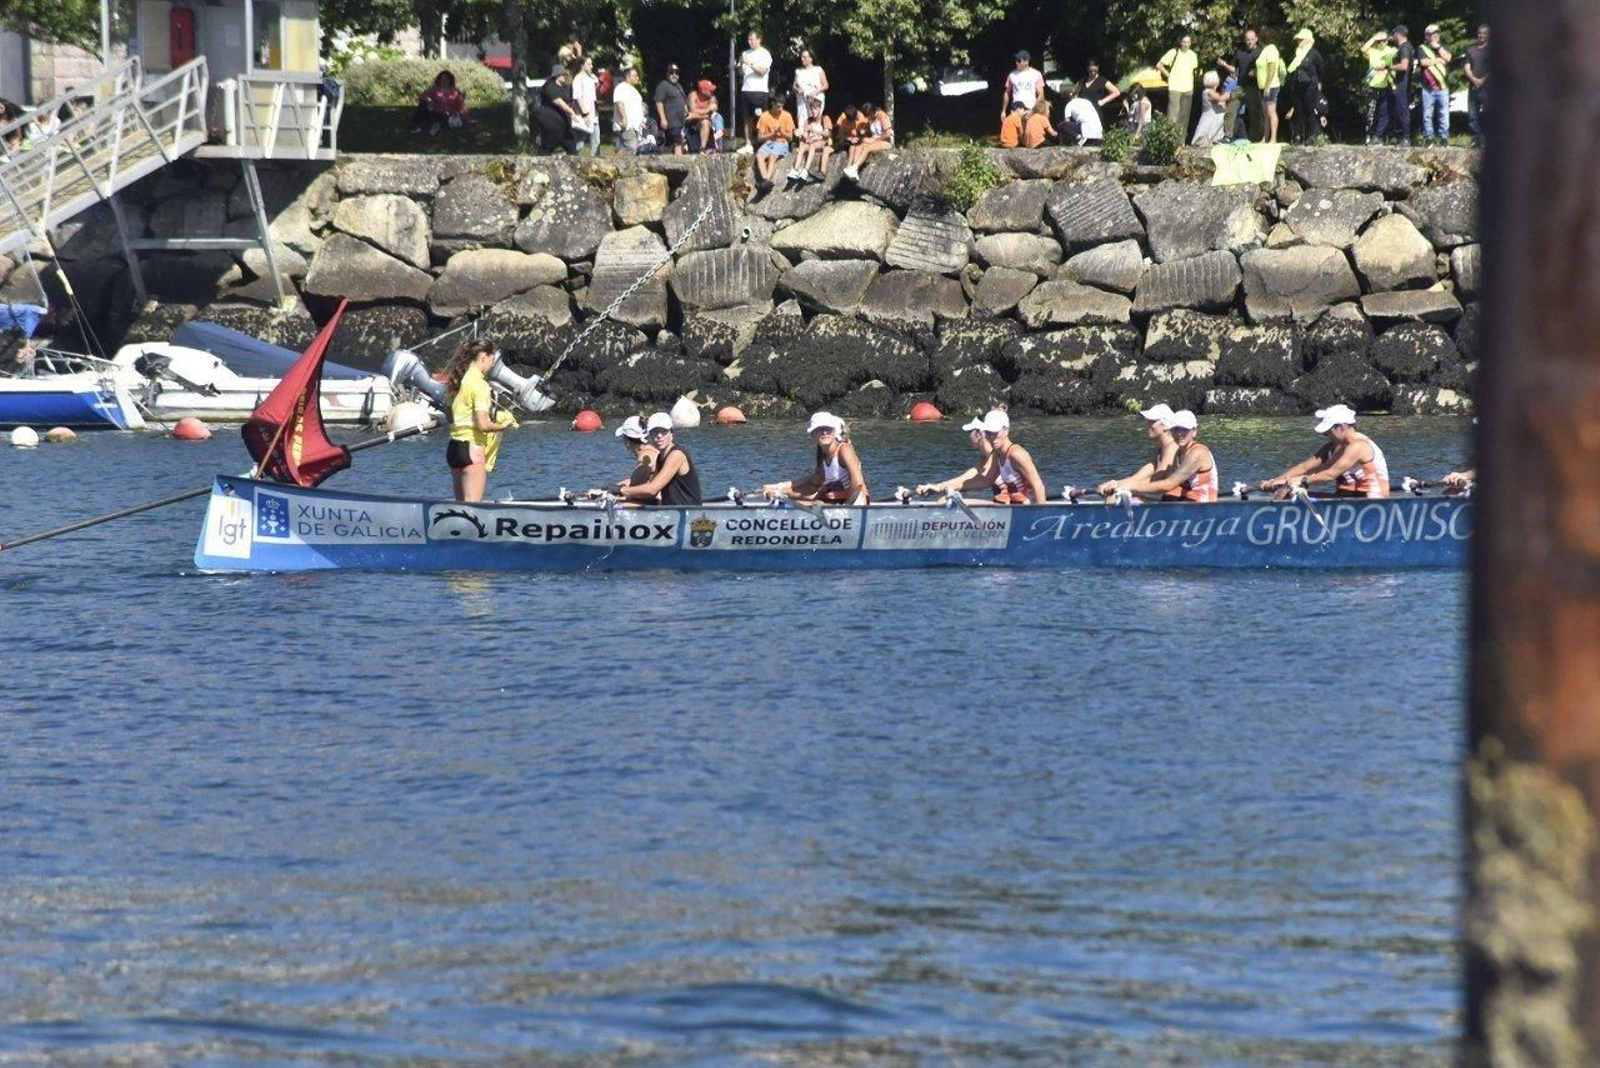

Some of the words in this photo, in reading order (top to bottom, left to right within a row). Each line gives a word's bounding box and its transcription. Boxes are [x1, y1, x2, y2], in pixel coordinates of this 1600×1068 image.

[297, 504, 373, 524] XUNTA
[298, 522, 326, 537] DE
[333, 523, 422, 539] GALICIA
[495, 517, 675, 542] Repainox
[725, 518, 824, 531] CONCELLO
[829, 518, 853, 530] DE
[1022, 508, 1242, 548] Arealonga
[731, 534, 843, 545] REDONDELA
